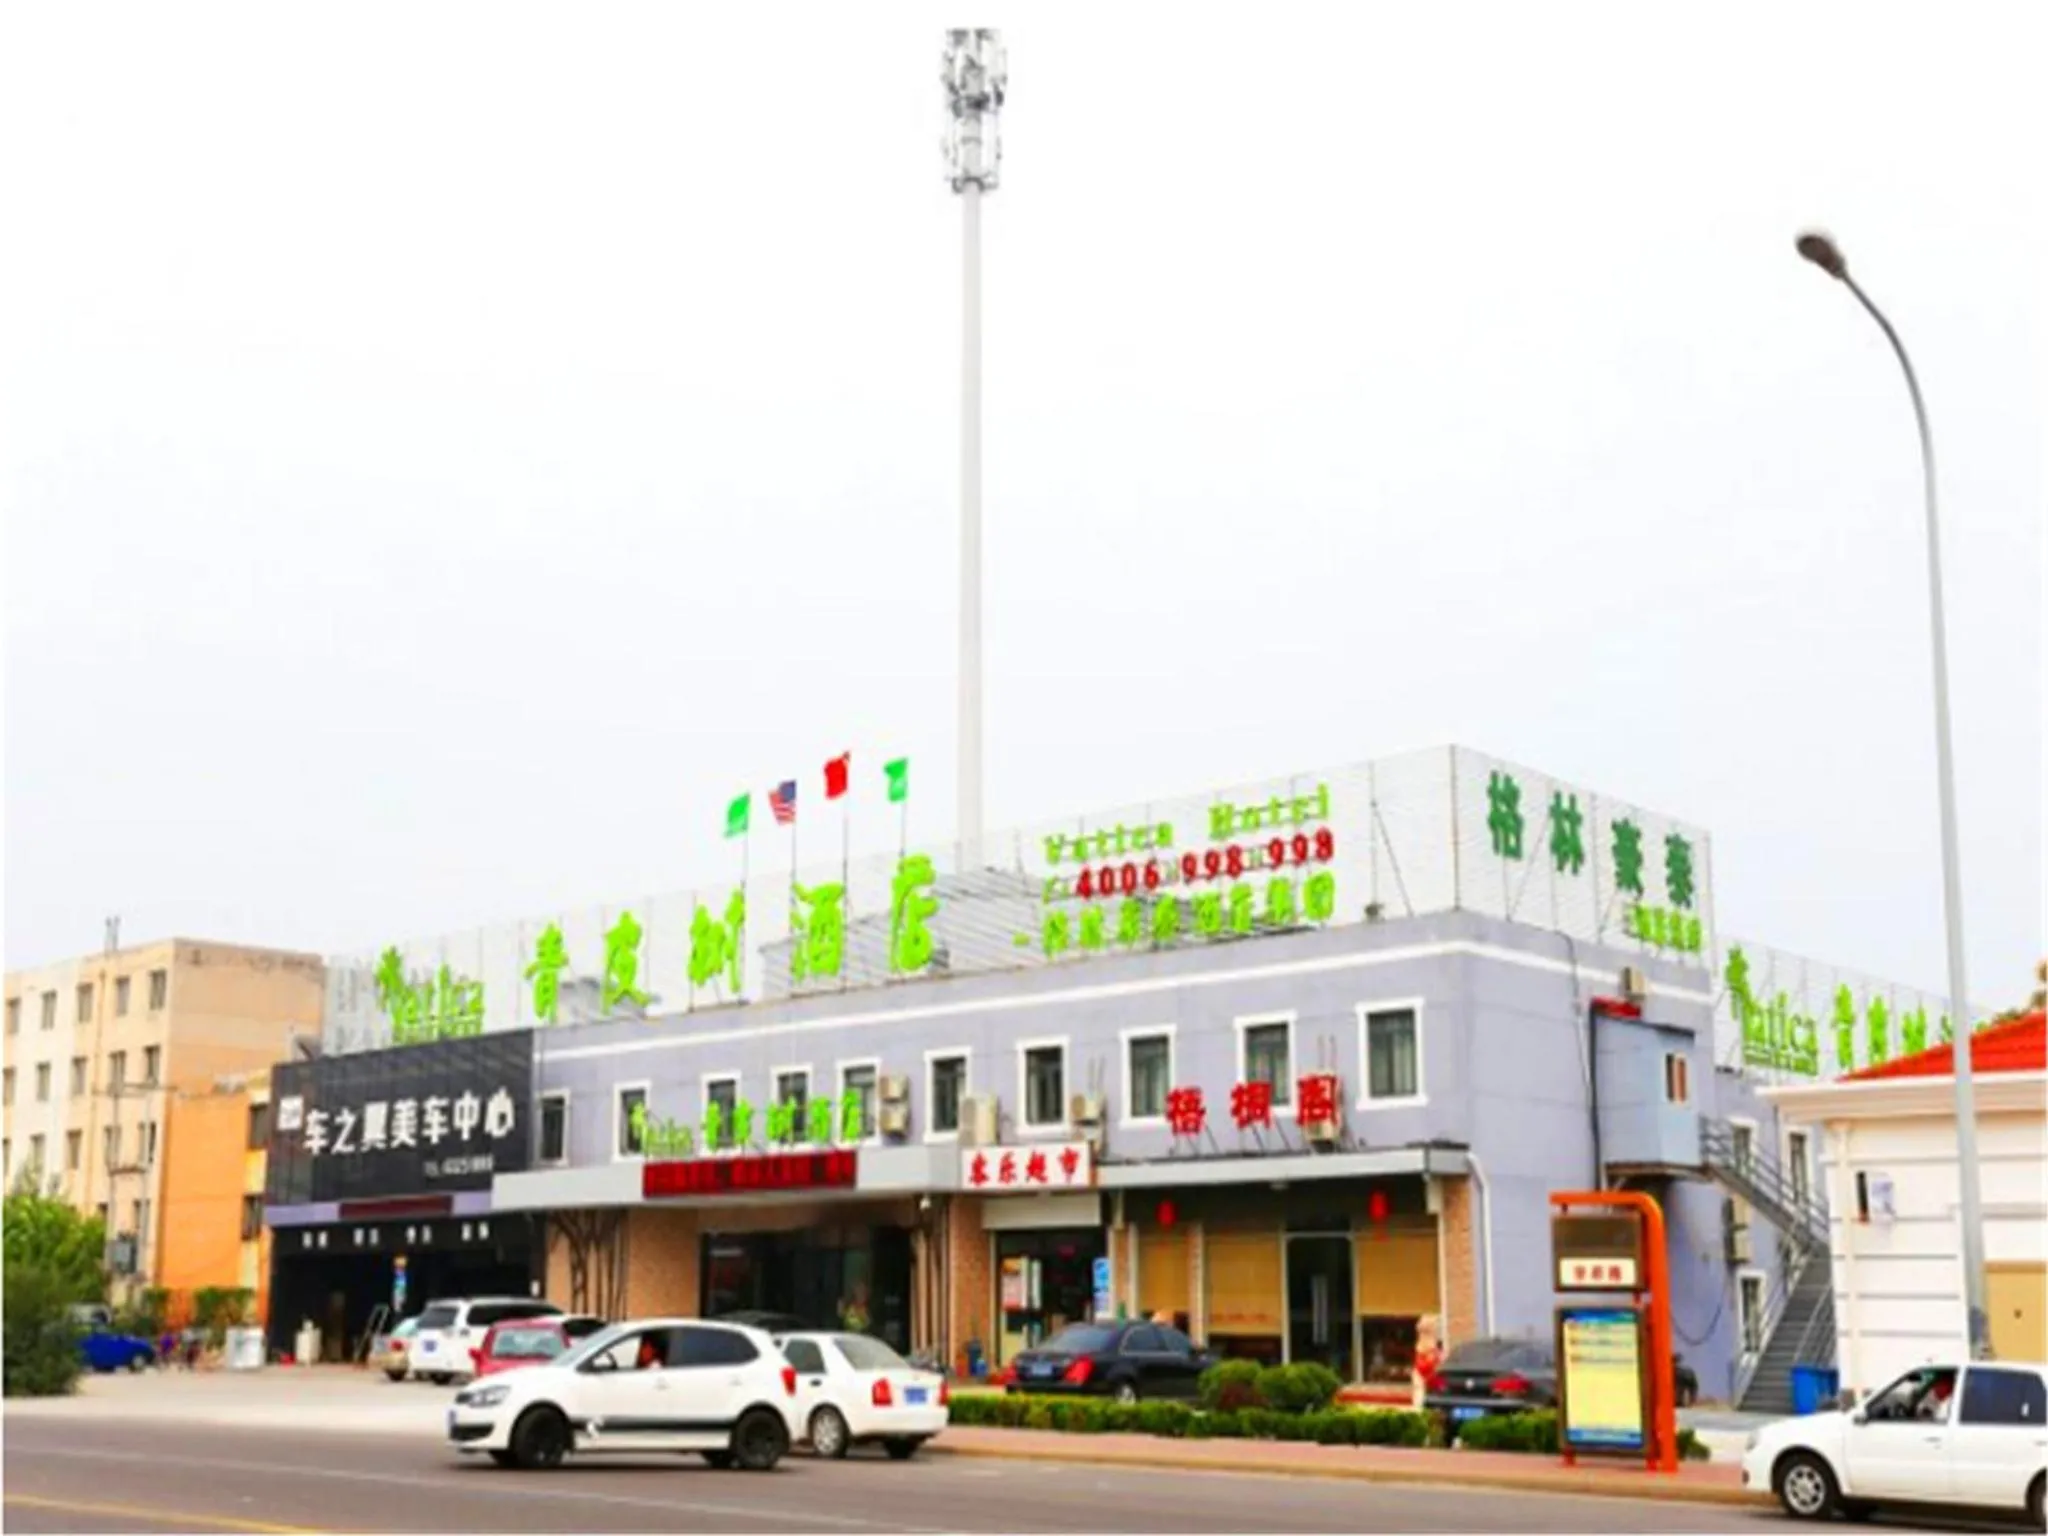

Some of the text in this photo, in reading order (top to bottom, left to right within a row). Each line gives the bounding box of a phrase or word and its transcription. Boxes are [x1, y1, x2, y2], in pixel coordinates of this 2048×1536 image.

[1208, 783, 1329, 841] Hotel
[1487, 769, 1694, 909] 格林豪泰
[523, 853, 939, 1024] 青皮树酒店
